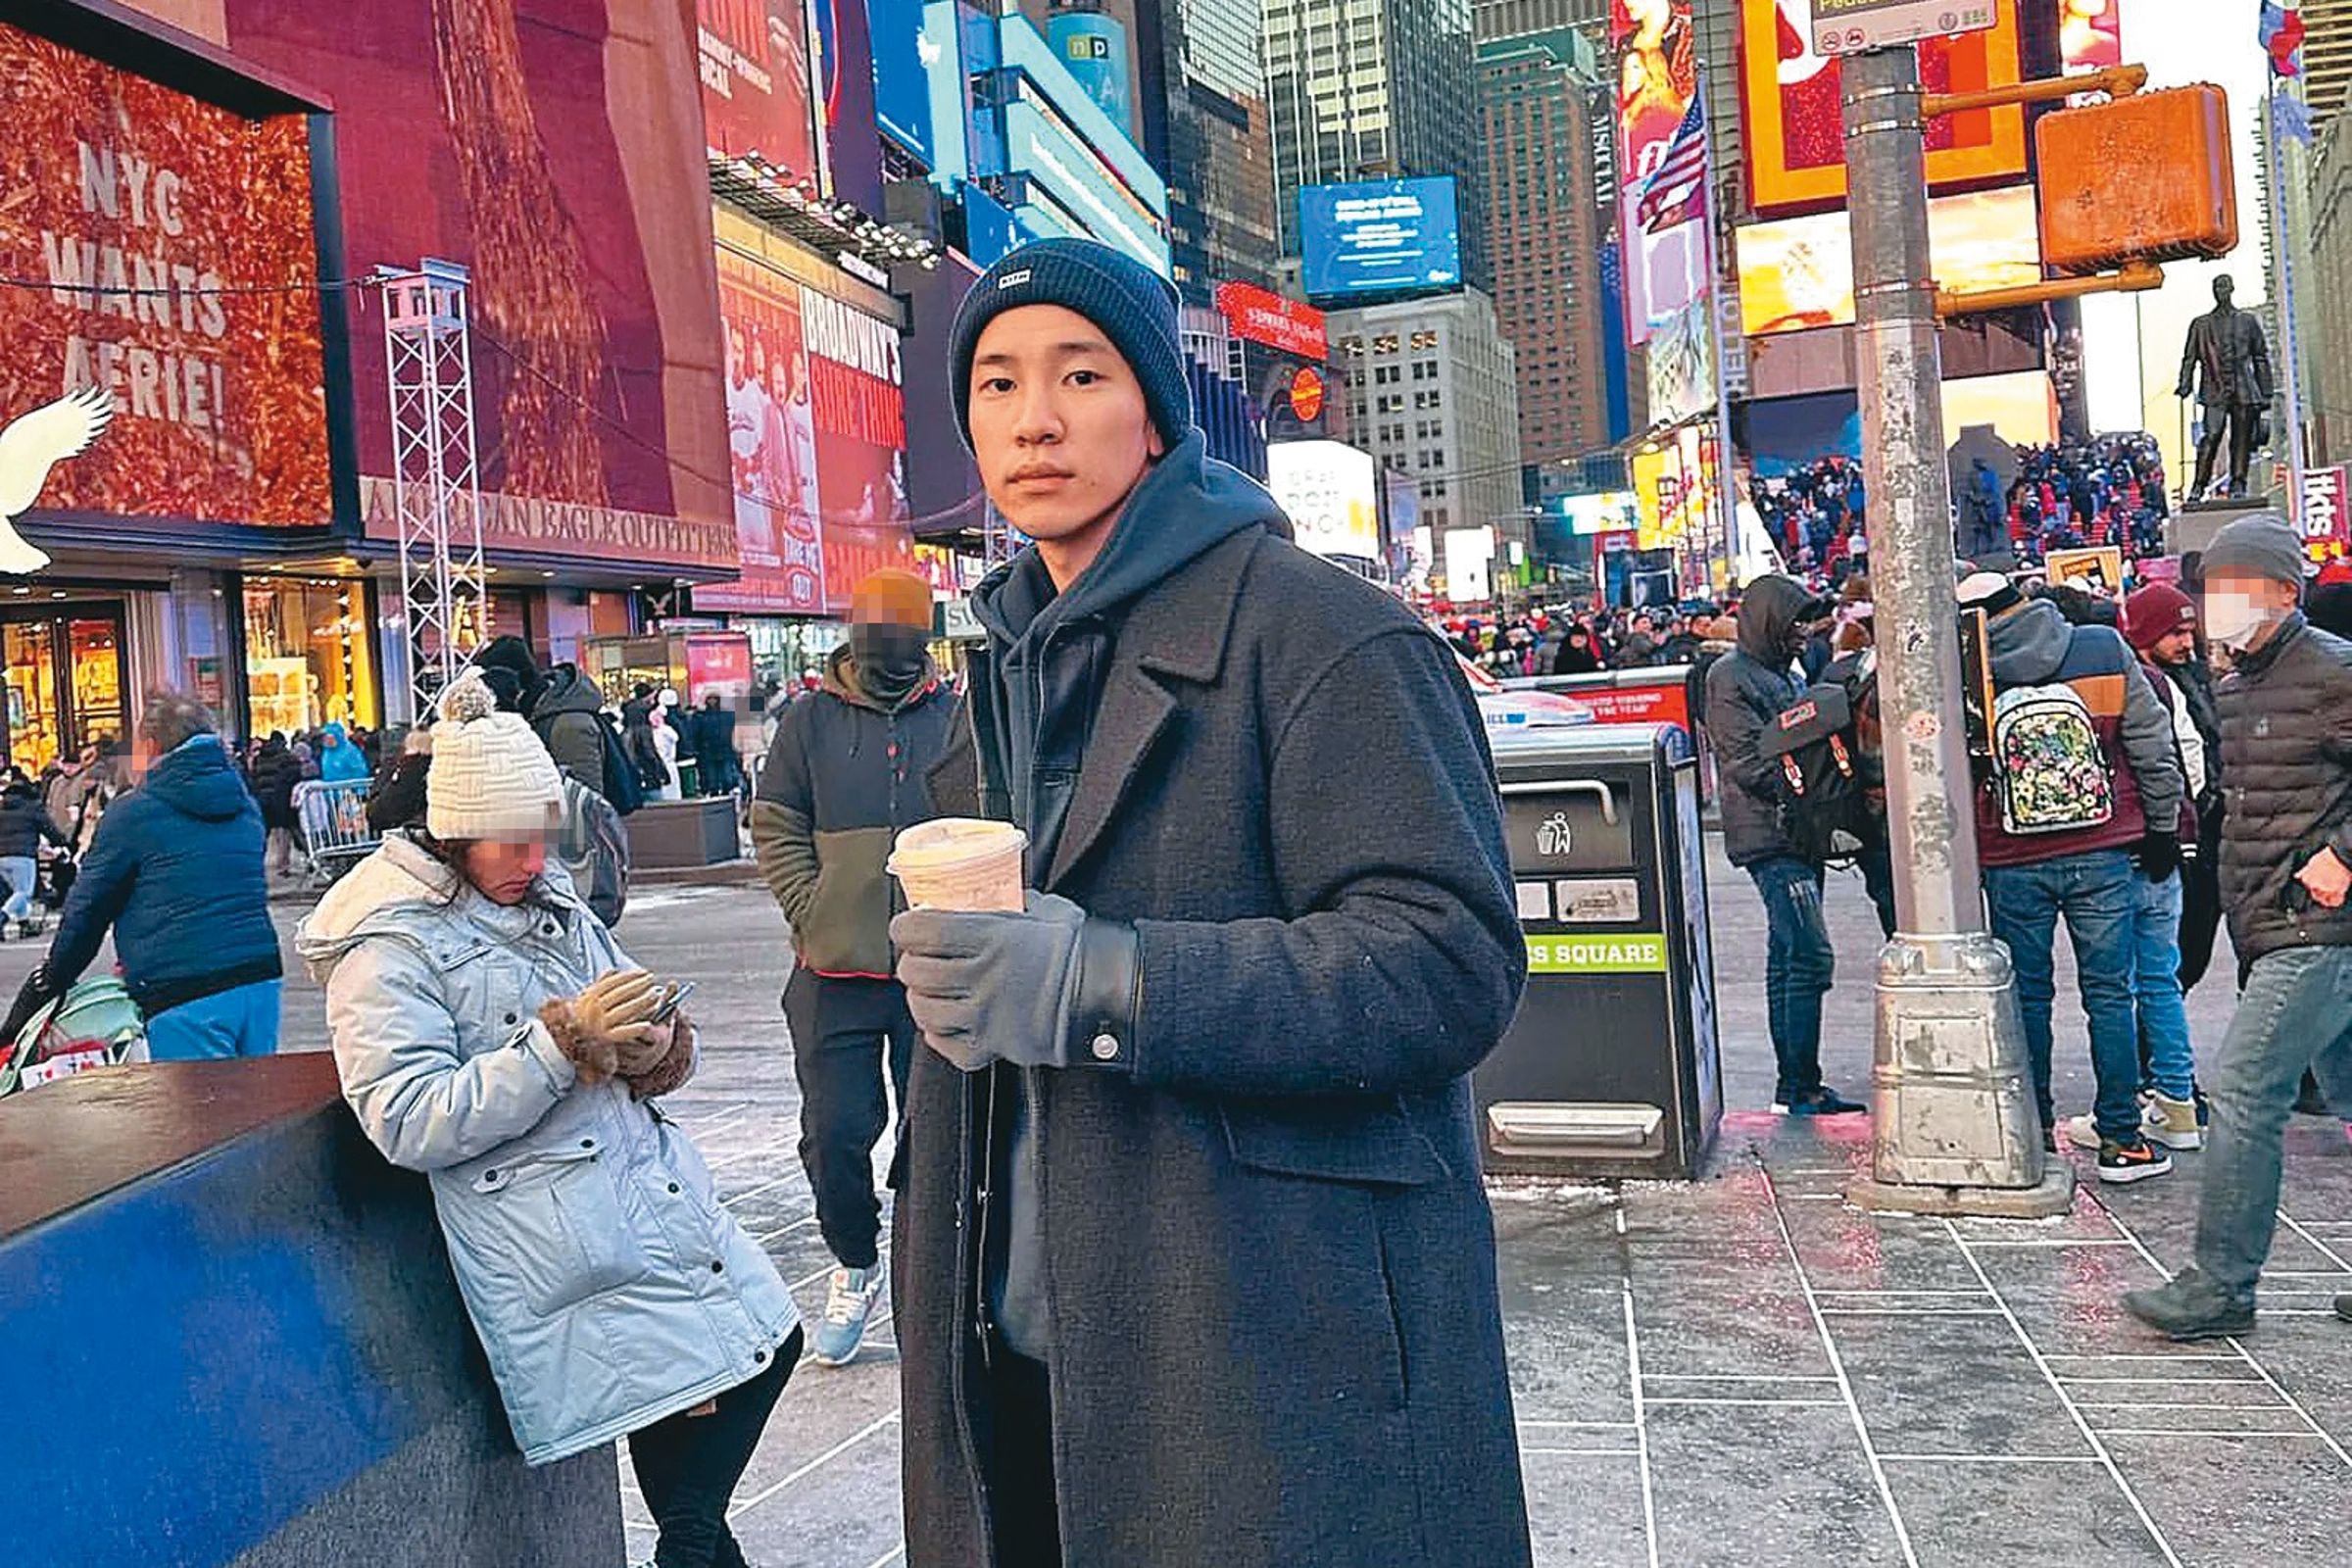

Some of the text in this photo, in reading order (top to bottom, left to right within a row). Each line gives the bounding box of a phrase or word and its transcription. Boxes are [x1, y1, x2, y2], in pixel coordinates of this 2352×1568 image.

[77, 140, 185, 238] NYC
[40, 228, 229, 340] WANTS
[62, 333, 224, 433] AERIE!
[541, 501, 617, 546] EAGLE
[619, 514, 739, 557] OUTFITTERS
[1555, 944, 1659, 963] SQUARE
